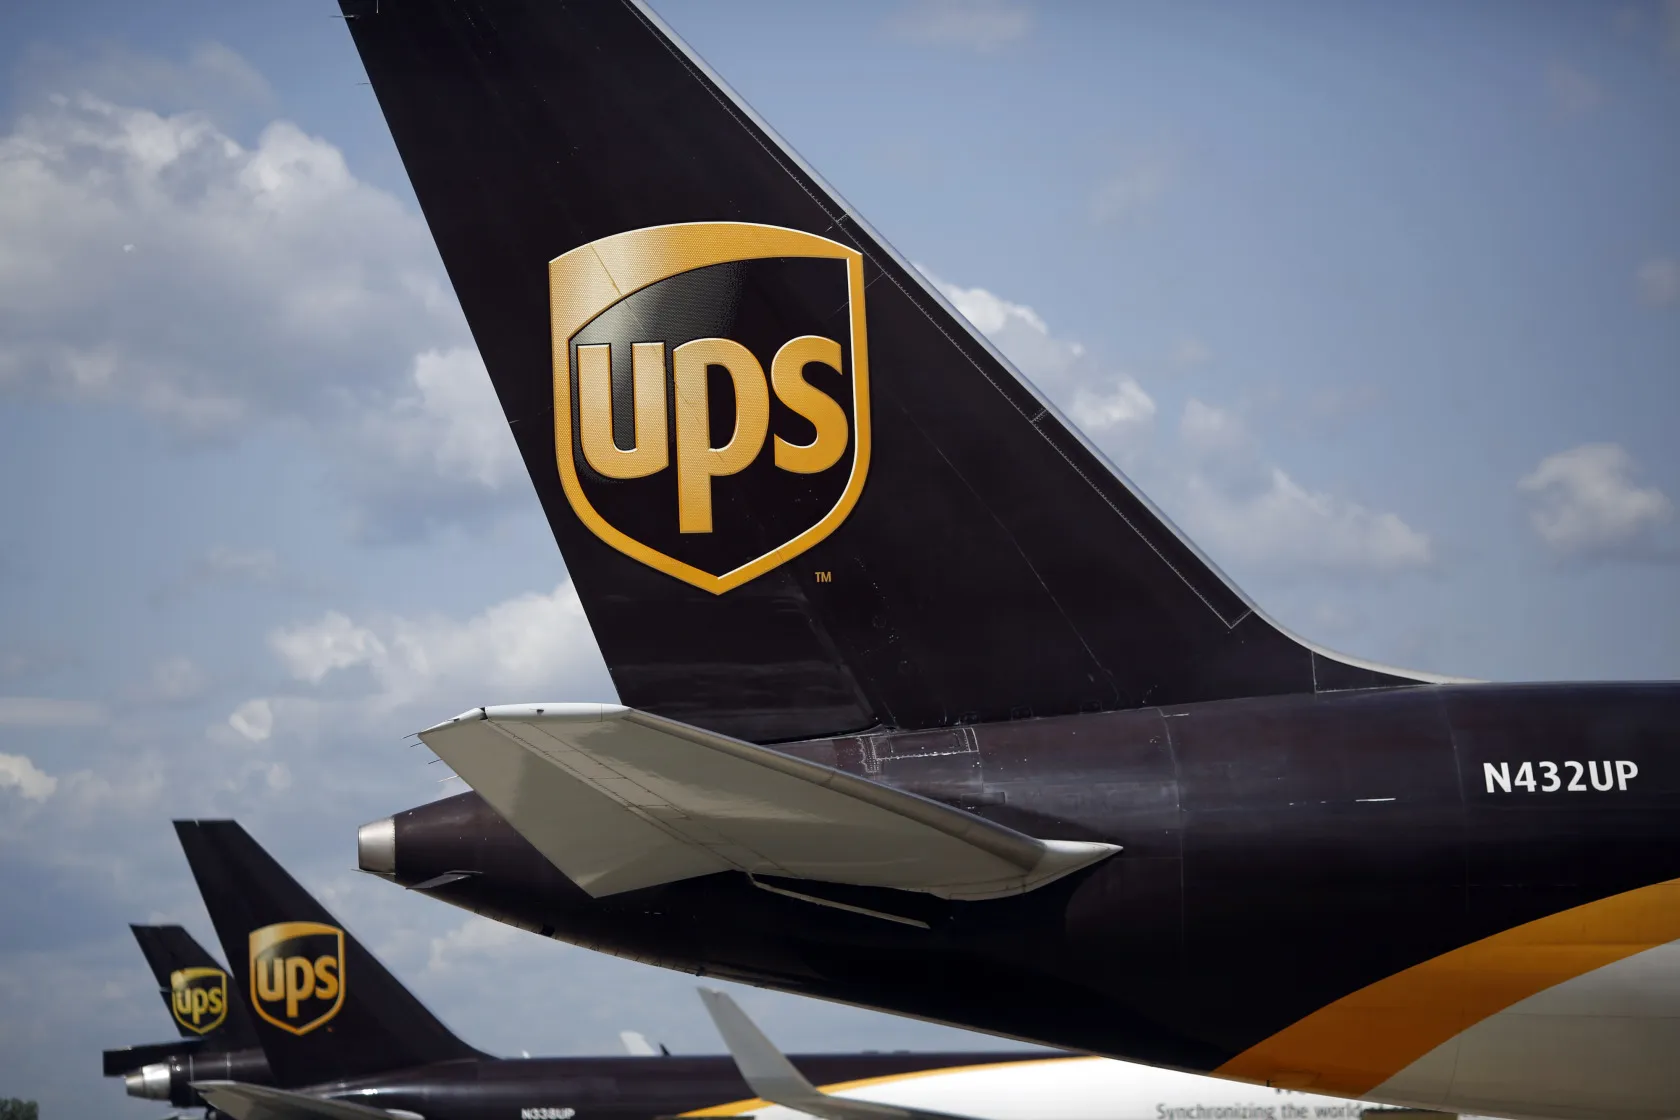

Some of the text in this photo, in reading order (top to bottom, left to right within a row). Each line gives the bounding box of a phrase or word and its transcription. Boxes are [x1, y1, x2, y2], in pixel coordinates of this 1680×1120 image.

[577, 335, 848, 533] ups
[815, 571, 832, 583] TM
[1483, 760, 1639, 793] N432UP
[256, 955, 339, 1018] ups
[176, 987, 223, 1025] ups
[1155, 1102, 1275, 1120] Synchronizing
[1281, 1103, 1308, 1119] the
[1314, 1102, 1362, 1119] world
